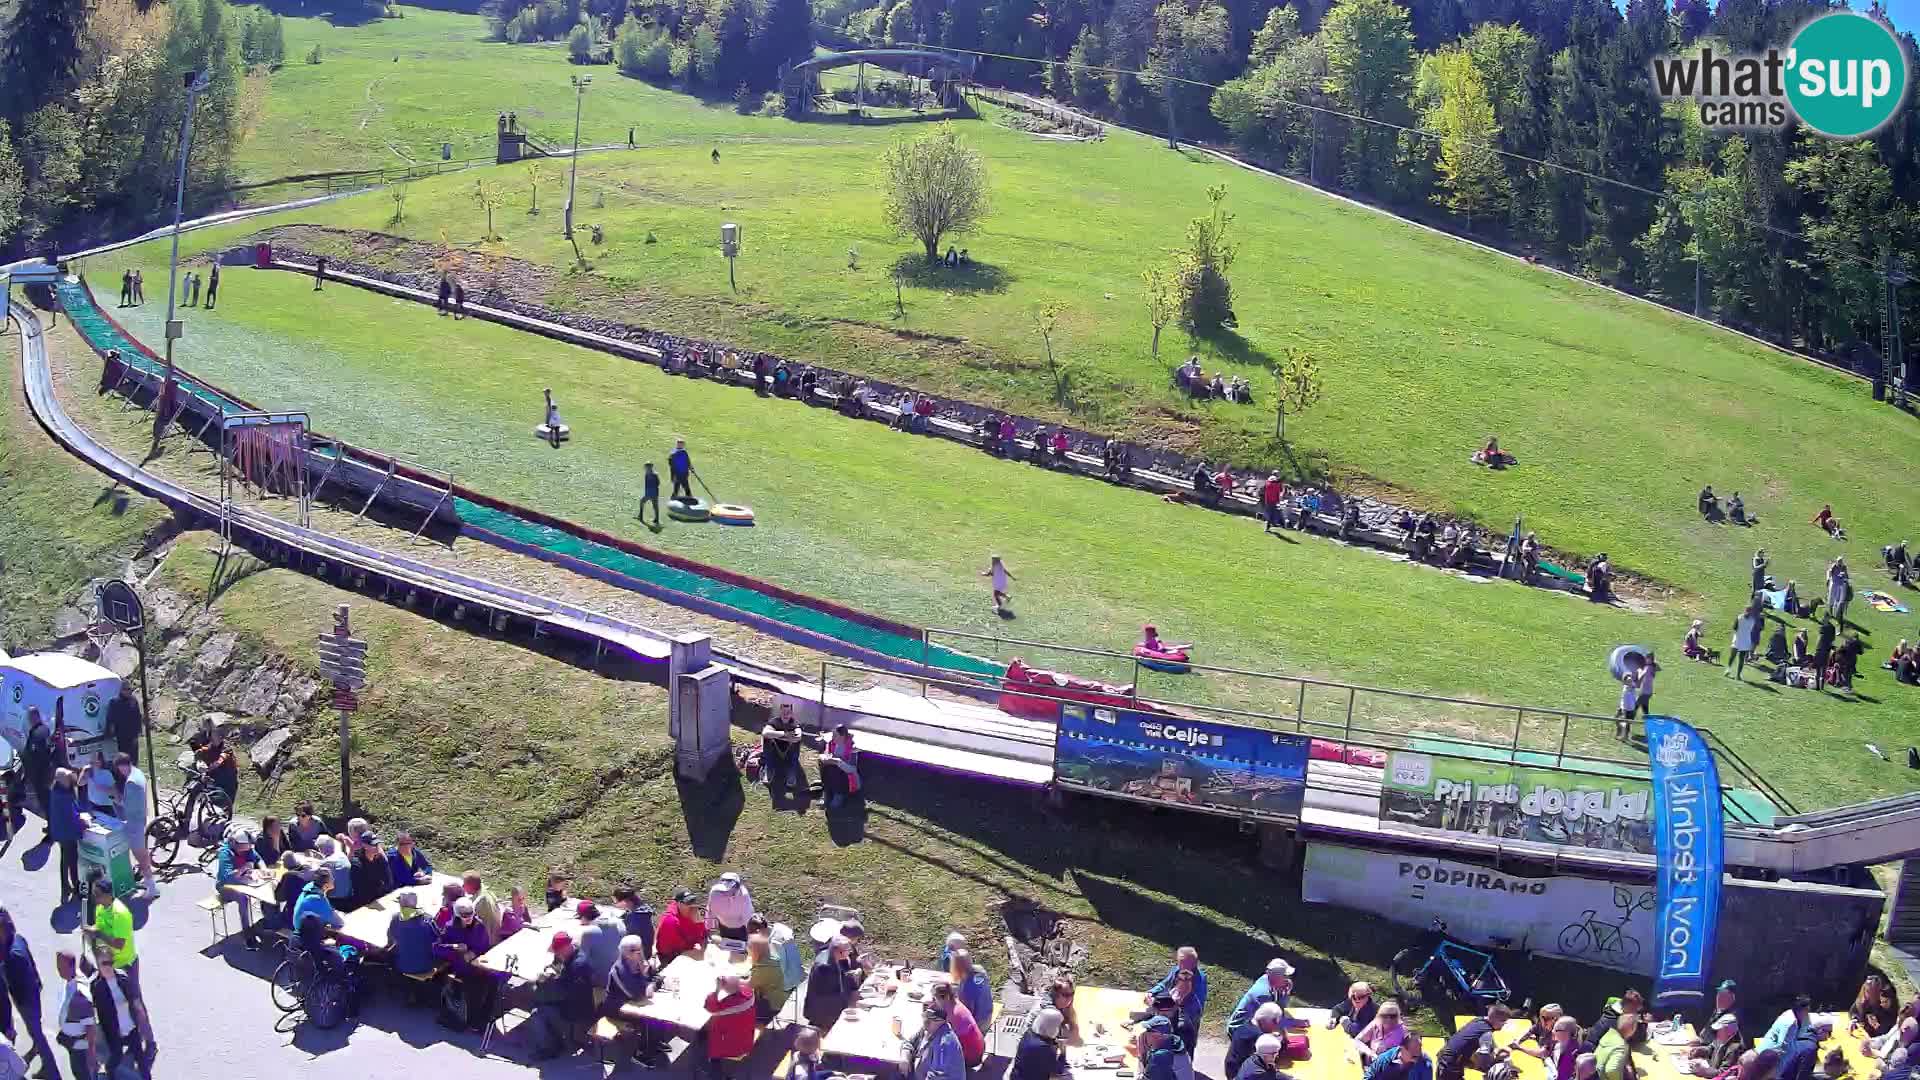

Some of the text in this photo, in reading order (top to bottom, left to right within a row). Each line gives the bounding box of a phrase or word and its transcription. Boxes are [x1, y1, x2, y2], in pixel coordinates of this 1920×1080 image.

[1163, 725, 1209, 747] Celje
[1434, 778, 1472, 802] Pri
[1476, 784, 1519, 804] nas
[1399, 861, 1547, 896] PODPIRAMO
